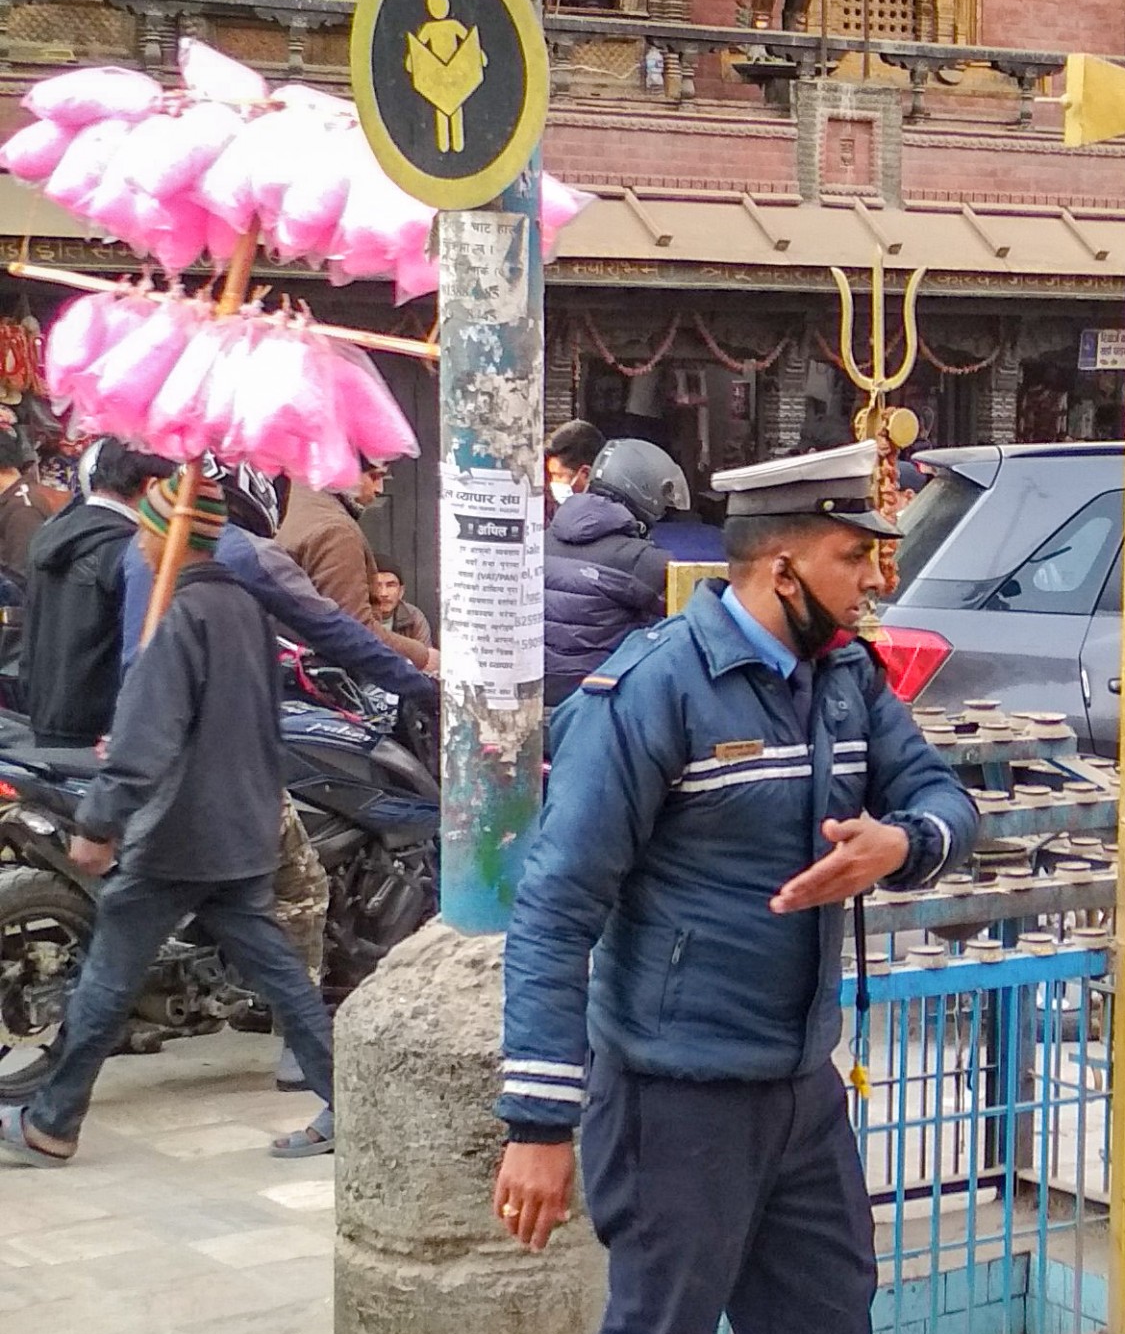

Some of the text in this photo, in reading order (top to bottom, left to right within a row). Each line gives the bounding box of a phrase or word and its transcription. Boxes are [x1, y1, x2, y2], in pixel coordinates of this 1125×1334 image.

[456, 491, 496, 505] व्यापार
[499, 494, 520, 505] संघ
[477, 522, 508, 538] अपिल
